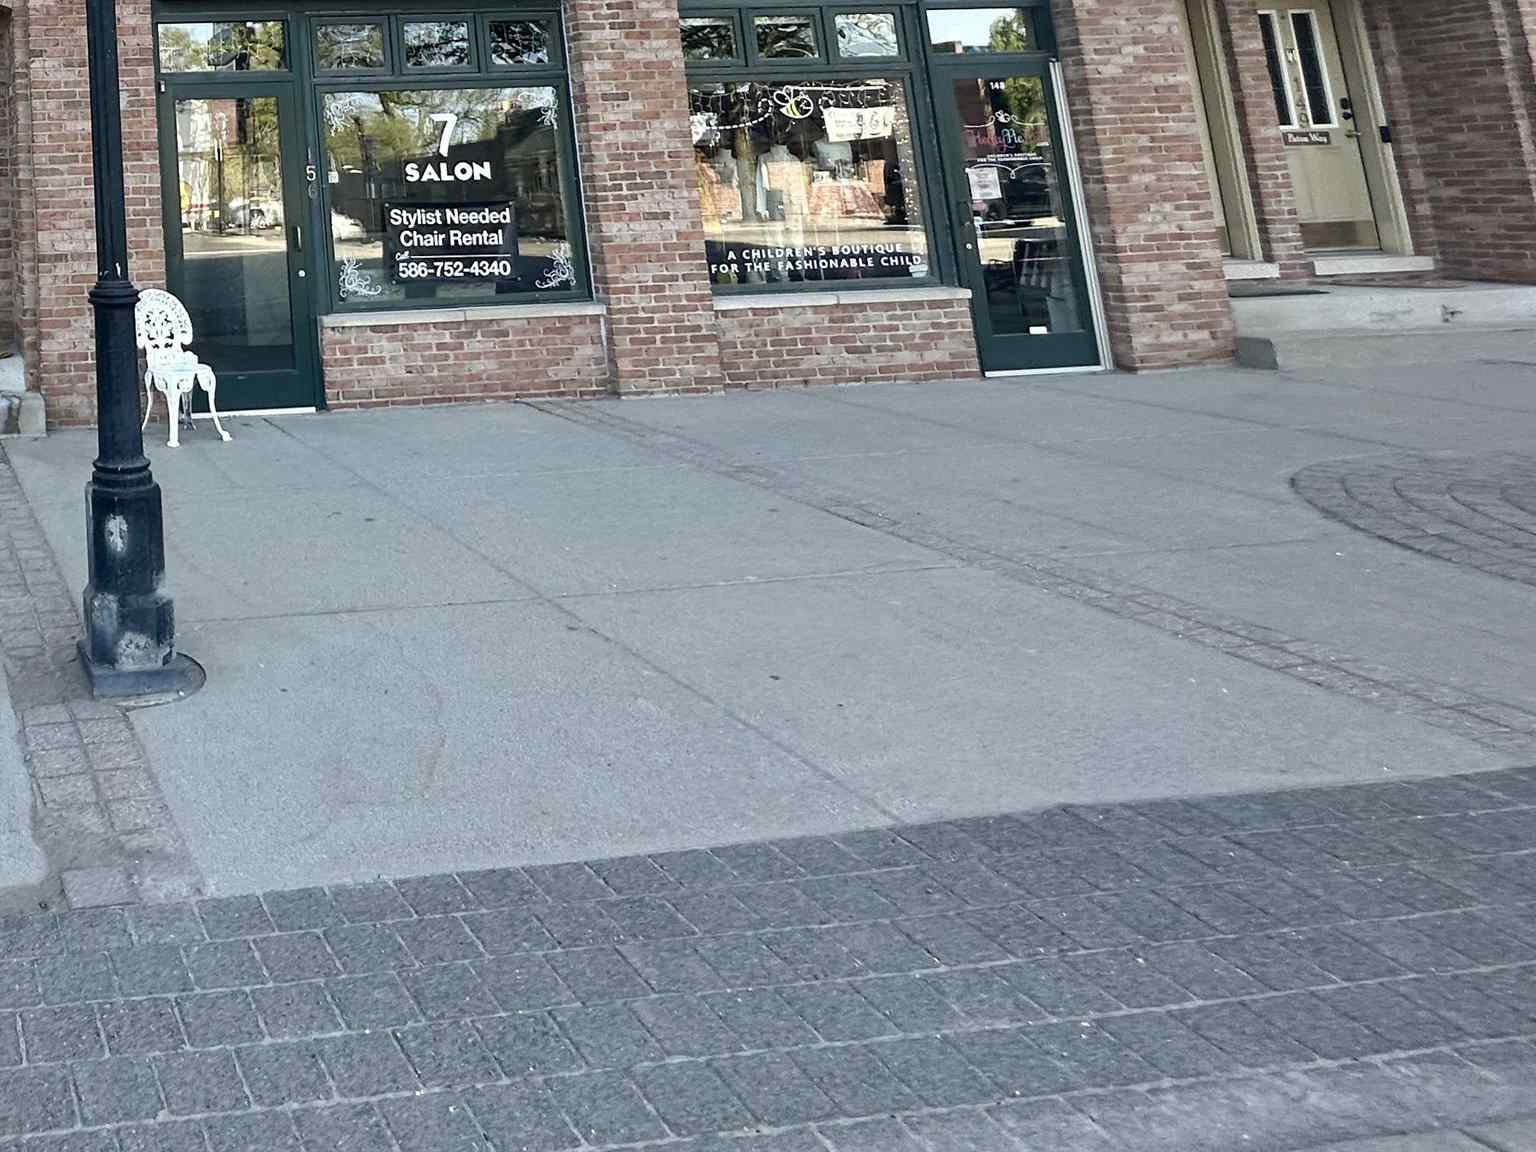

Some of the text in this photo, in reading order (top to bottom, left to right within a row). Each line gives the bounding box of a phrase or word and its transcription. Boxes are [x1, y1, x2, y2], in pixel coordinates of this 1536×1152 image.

[430, 112, 458, 158] 7
[405, 161, 492, 182] SALON
[390, 207, 511, 228] Stylist Needed
[400, 229, 503, 247] Chair Rental
[727, 243, 903, 261] A CHILDREN'S BOUTIQUE
[398, 260, 511, 278] 586-752-4340
[711, 255, 922, 274] FOR THE FASHIONABLE CHILD
